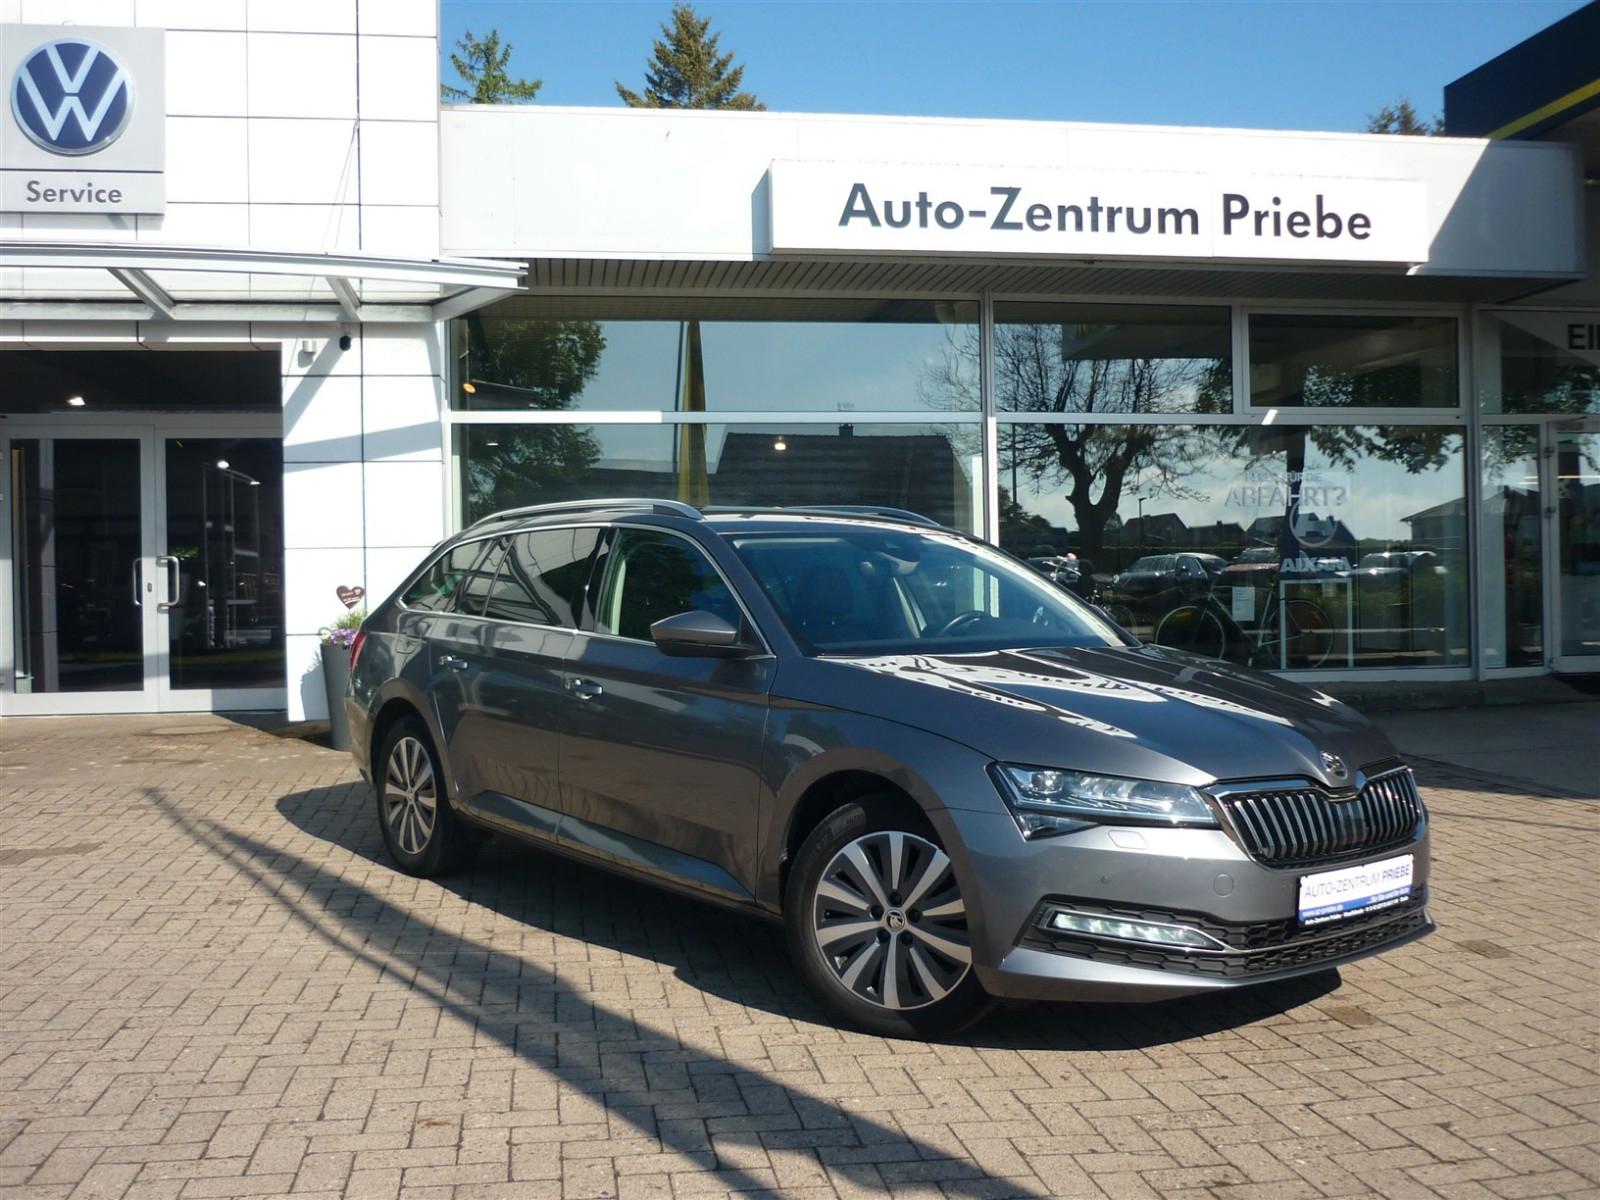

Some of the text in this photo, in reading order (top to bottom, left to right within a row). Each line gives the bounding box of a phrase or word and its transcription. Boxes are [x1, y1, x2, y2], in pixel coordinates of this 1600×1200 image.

[26, 180, 122, 203] Service
[838, 182, 1372, 241] Auto-Zentrum Priebe
[1567, 323, 1600, 351] EI
[1224, 486, 1348, 508] ABFAHRT?
[1304, 873, 1381, 897] AUTO-ZENTRUM
[1382, 864, 1410, 880] PRIEBE
